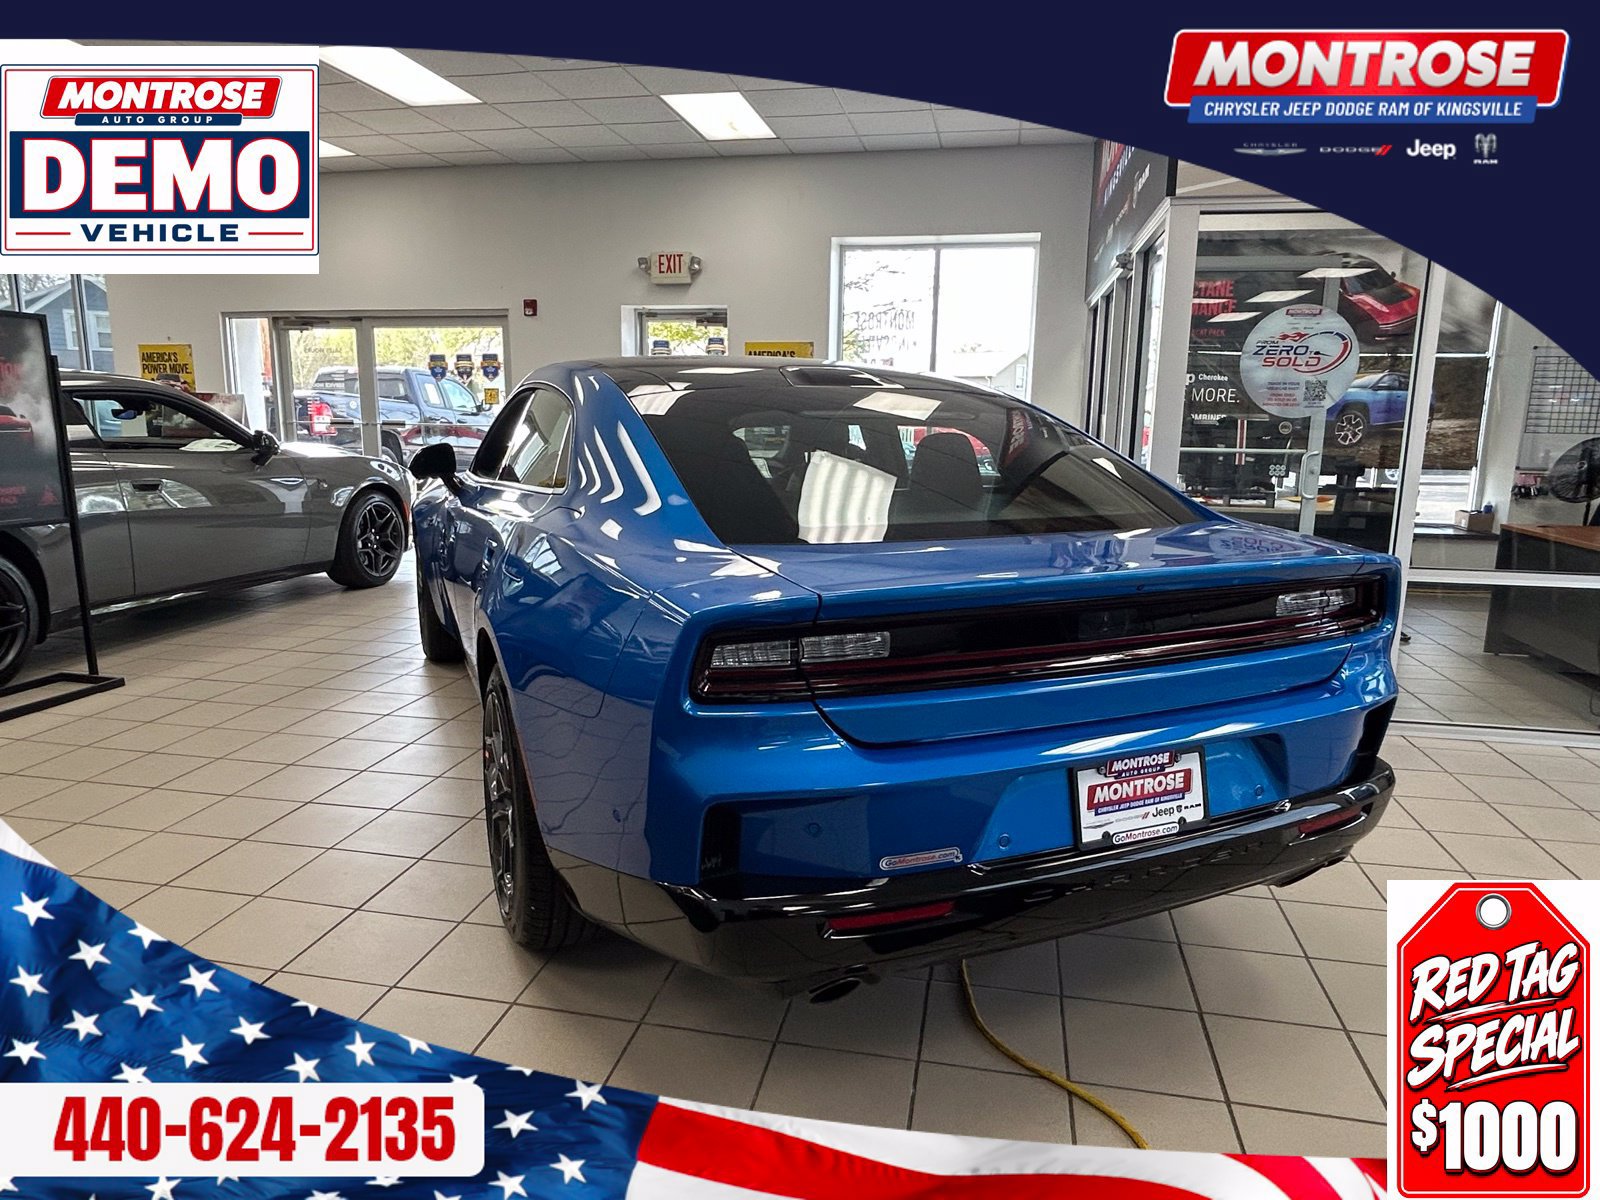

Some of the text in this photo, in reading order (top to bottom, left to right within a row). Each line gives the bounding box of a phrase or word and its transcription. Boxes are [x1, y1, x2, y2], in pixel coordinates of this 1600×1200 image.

[658, 253, 683, 273] EXIT
[141, 351, 179, 362] AMERICA'S
[1252, 345, 1310, 356] ZERO
[143, 363, 168, 374] POWER
[1262, 357, 1322, 367] SOLD
[1198, 373, 1229, 382] Cherokee
[1191, 387, 1240, 403] MORE.
[1110, 751, 1170, 772] MONTROSE
[1121, 766, 1161, 777] AUTO GROUP
[1092, 772, 1185, 803] MONTROSE
[1152, 804, 1175, 818] Jeep
[1114, 824, 1178, 844] GoMontrose.com
[885, 850, 956, 867] GoMontrose.com
